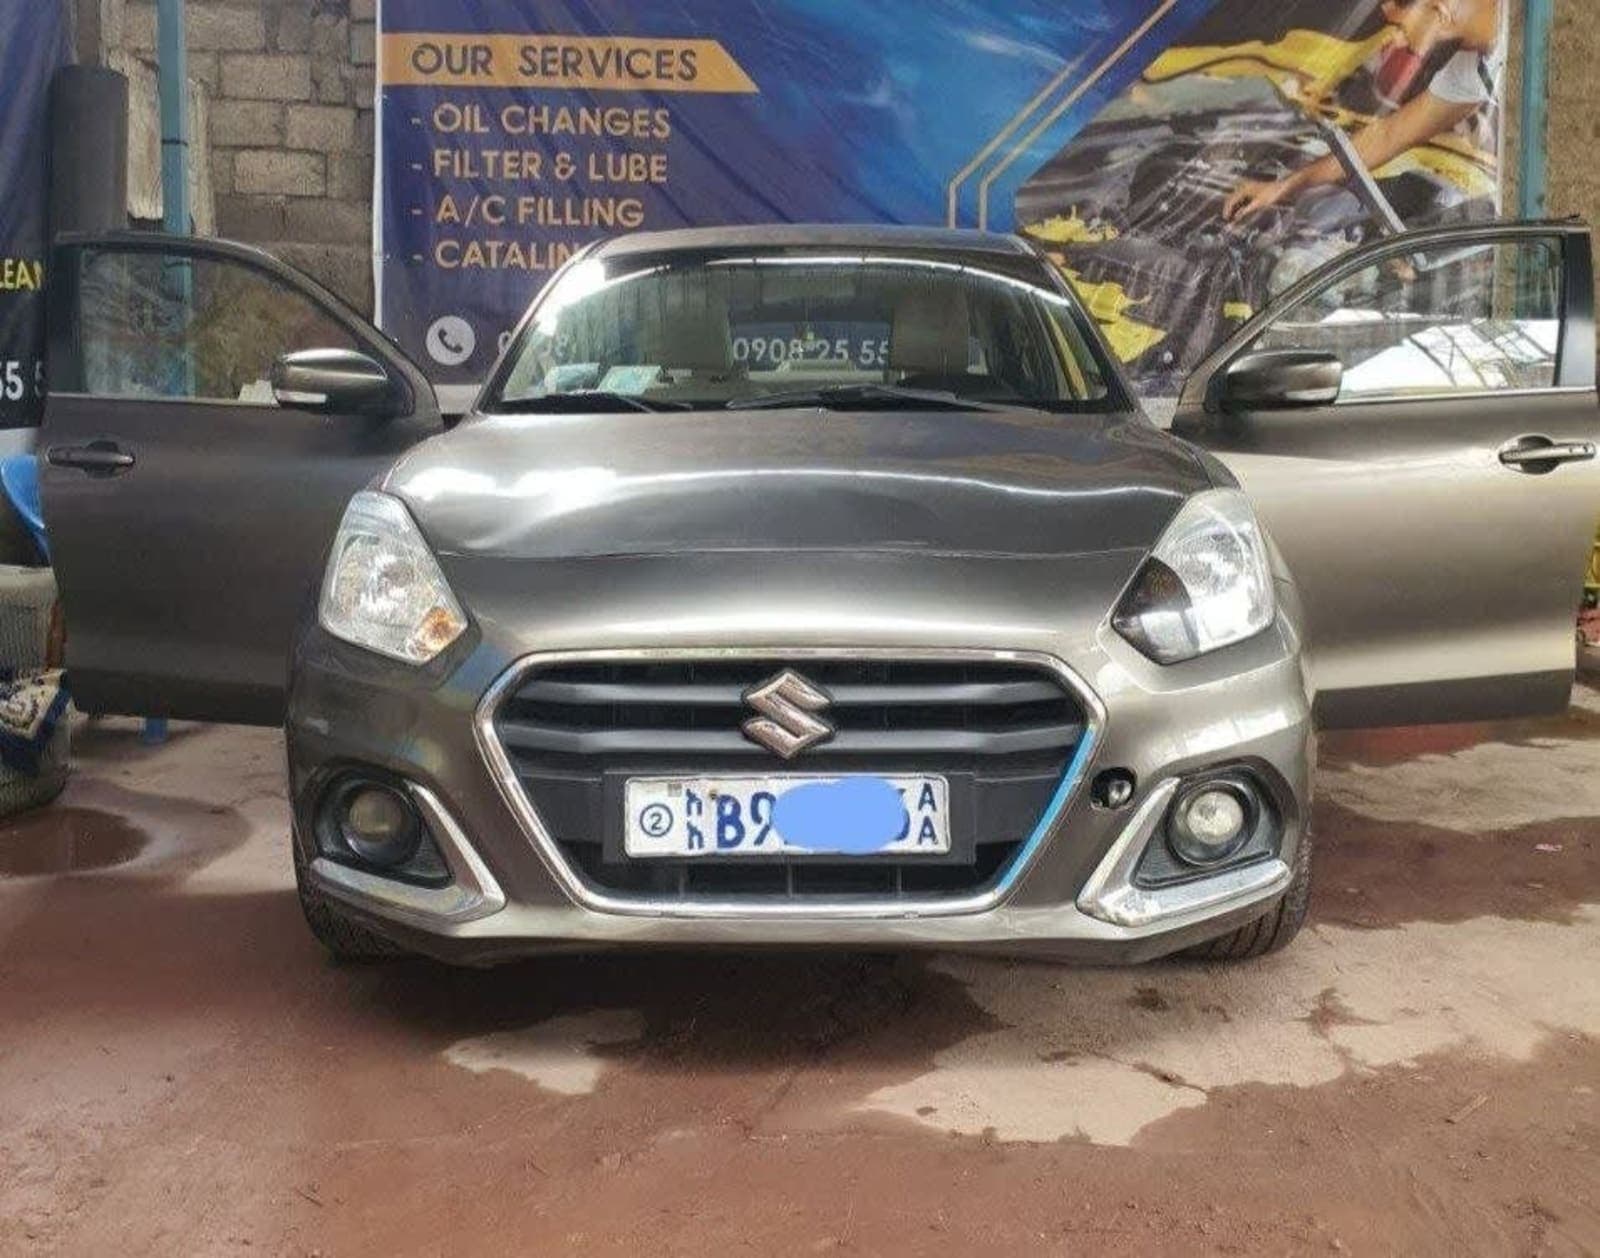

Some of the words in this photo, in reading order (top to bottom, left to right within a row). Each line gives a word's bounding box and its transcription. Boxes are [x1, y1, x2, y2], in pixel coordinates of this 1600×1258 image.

[411, 43, 494, 76] OUR
[519, 46, 698, 81] SERVICES
[433, 103, 490, 134] OIL
[502, 104, 671, 138] CHANGES
[434, 149, 542, 180] FILTER
[554, 153, 576, 180] &
[589, 153, 668, 183] LUBE
[435, 195, 506, 227] A/C
[518, 198, 645, 228] FILLING
